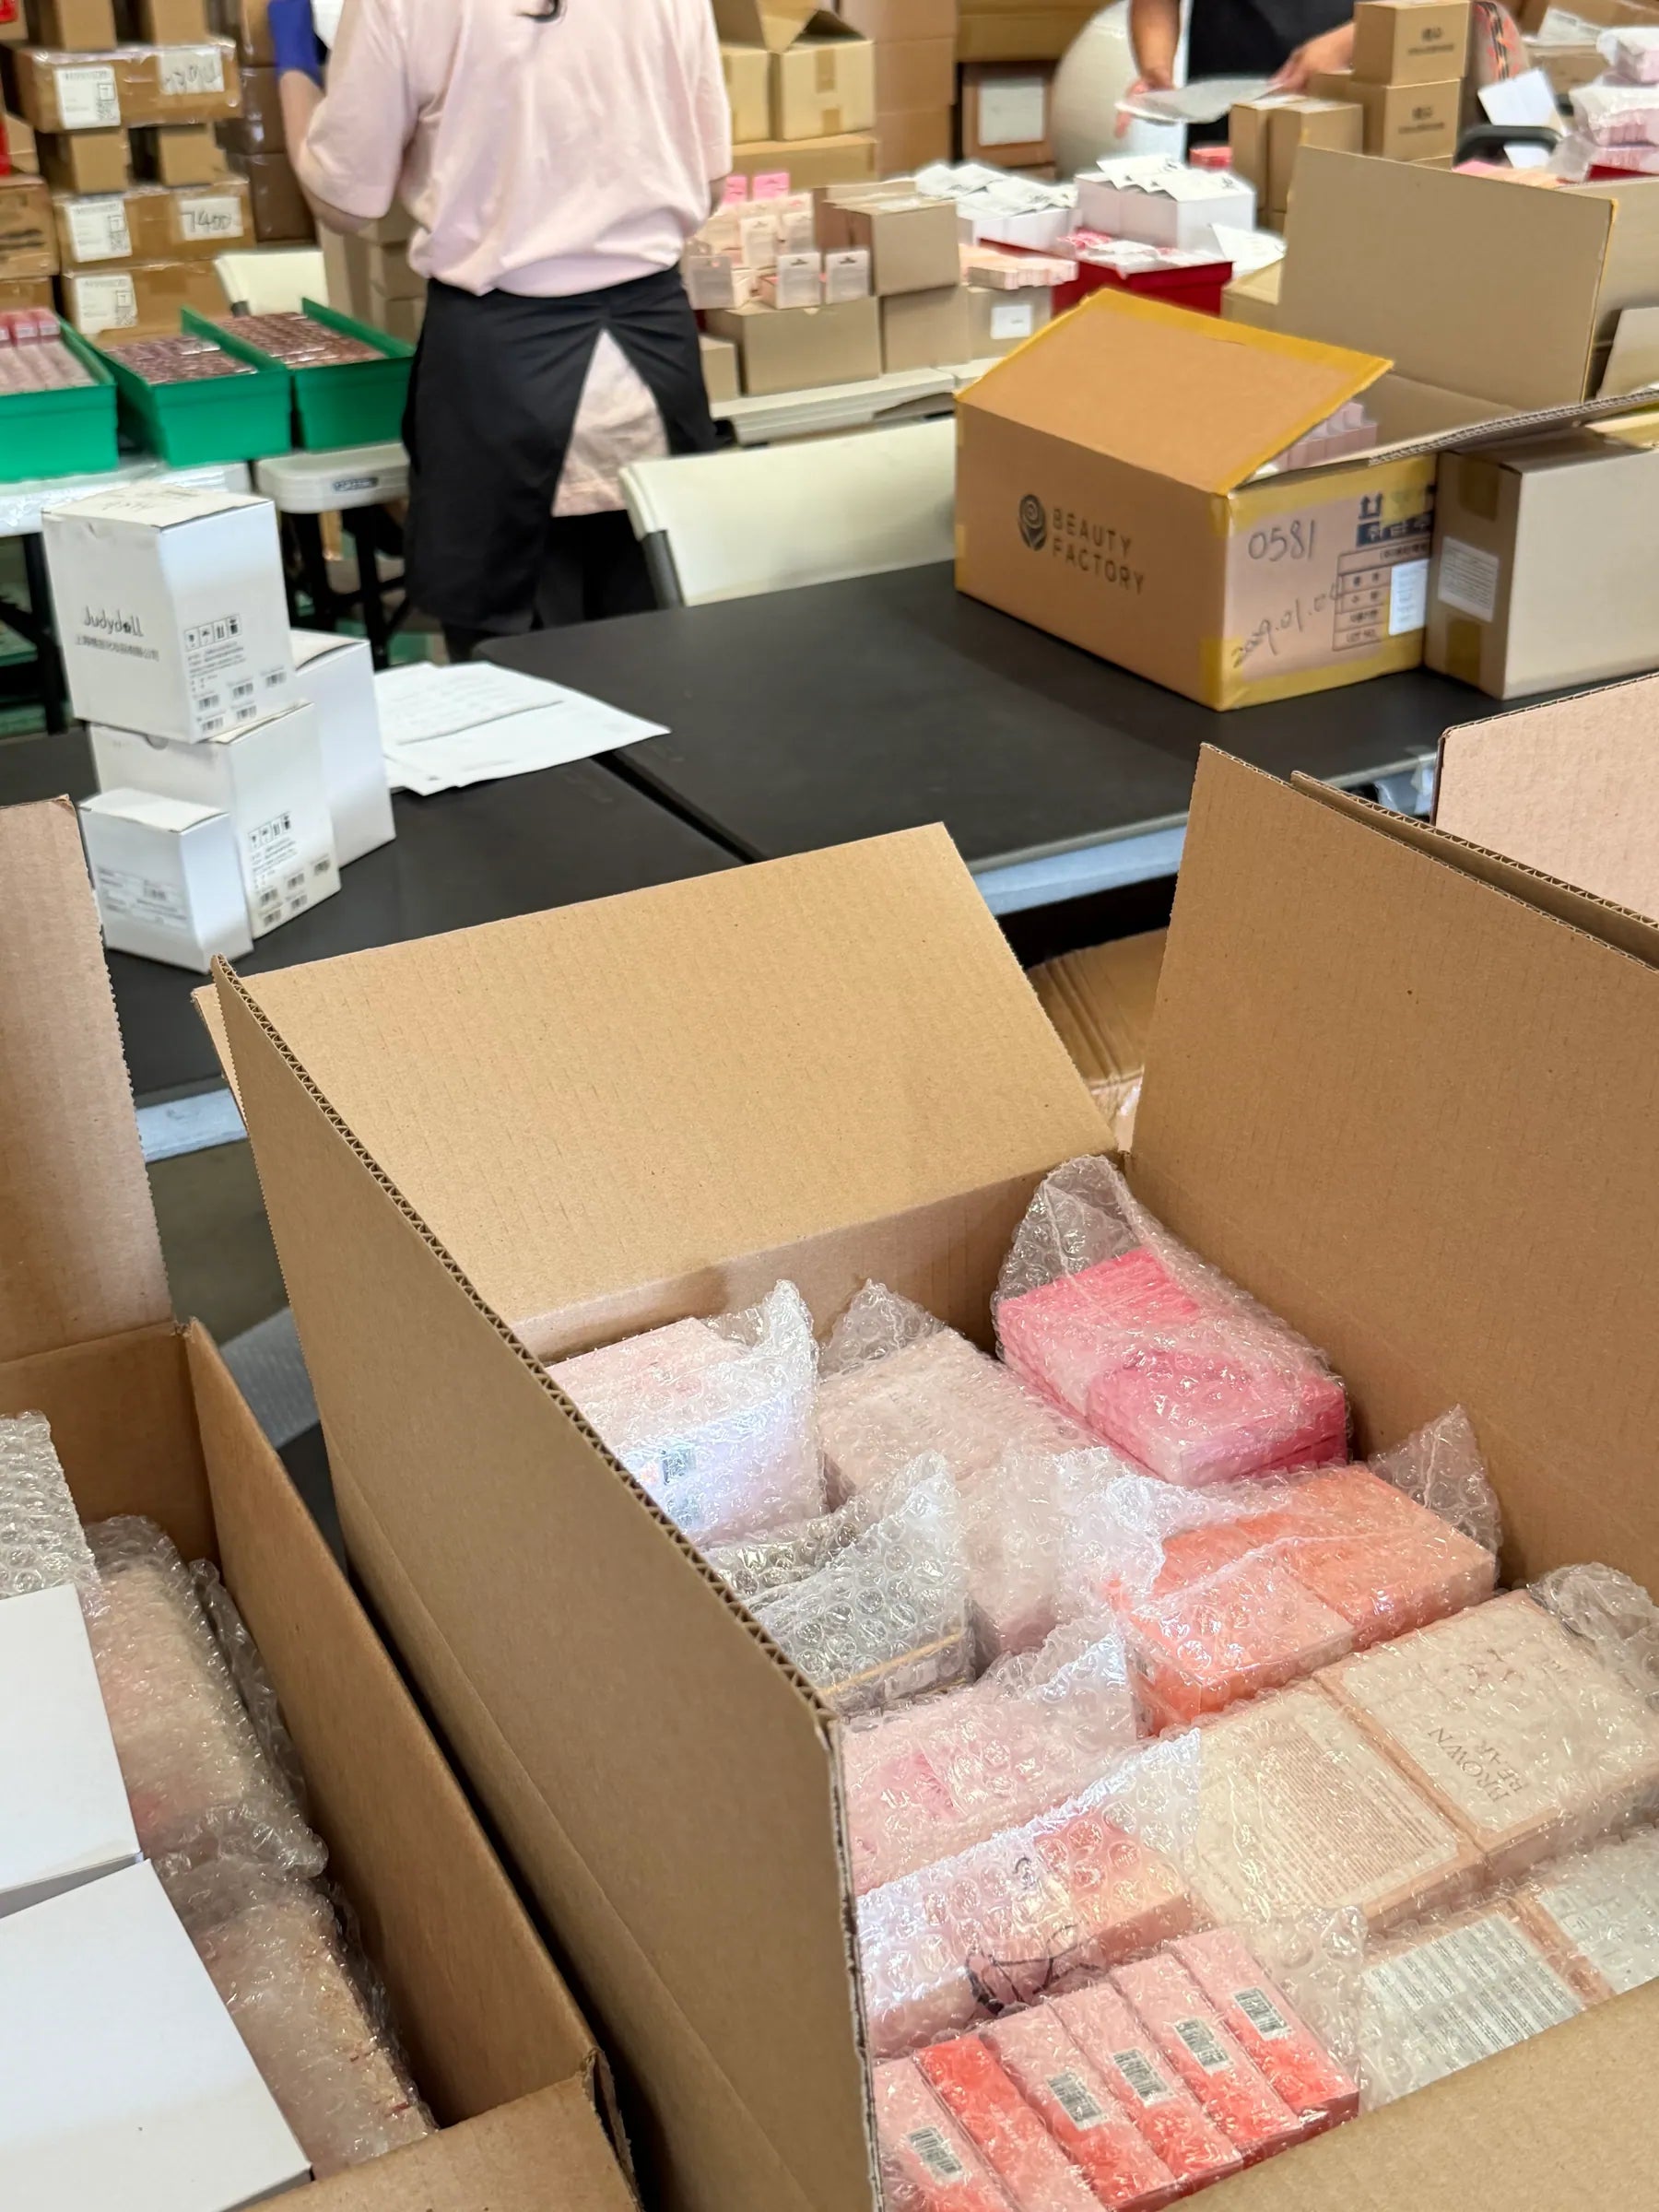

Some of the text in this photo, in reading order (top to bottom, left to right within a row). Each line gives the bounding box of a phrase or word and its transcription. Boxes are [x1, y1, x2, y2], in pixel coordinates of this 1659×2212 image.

[1053, 507, 1132, 559] BEAUTY
[1248, 519, 1315, 561] 0581
[1053, 537, 1145, 595] FACTORY
[84, 605, 145, 638] Judydoll
[1427, 1726, 1512, 1803] BROWN
